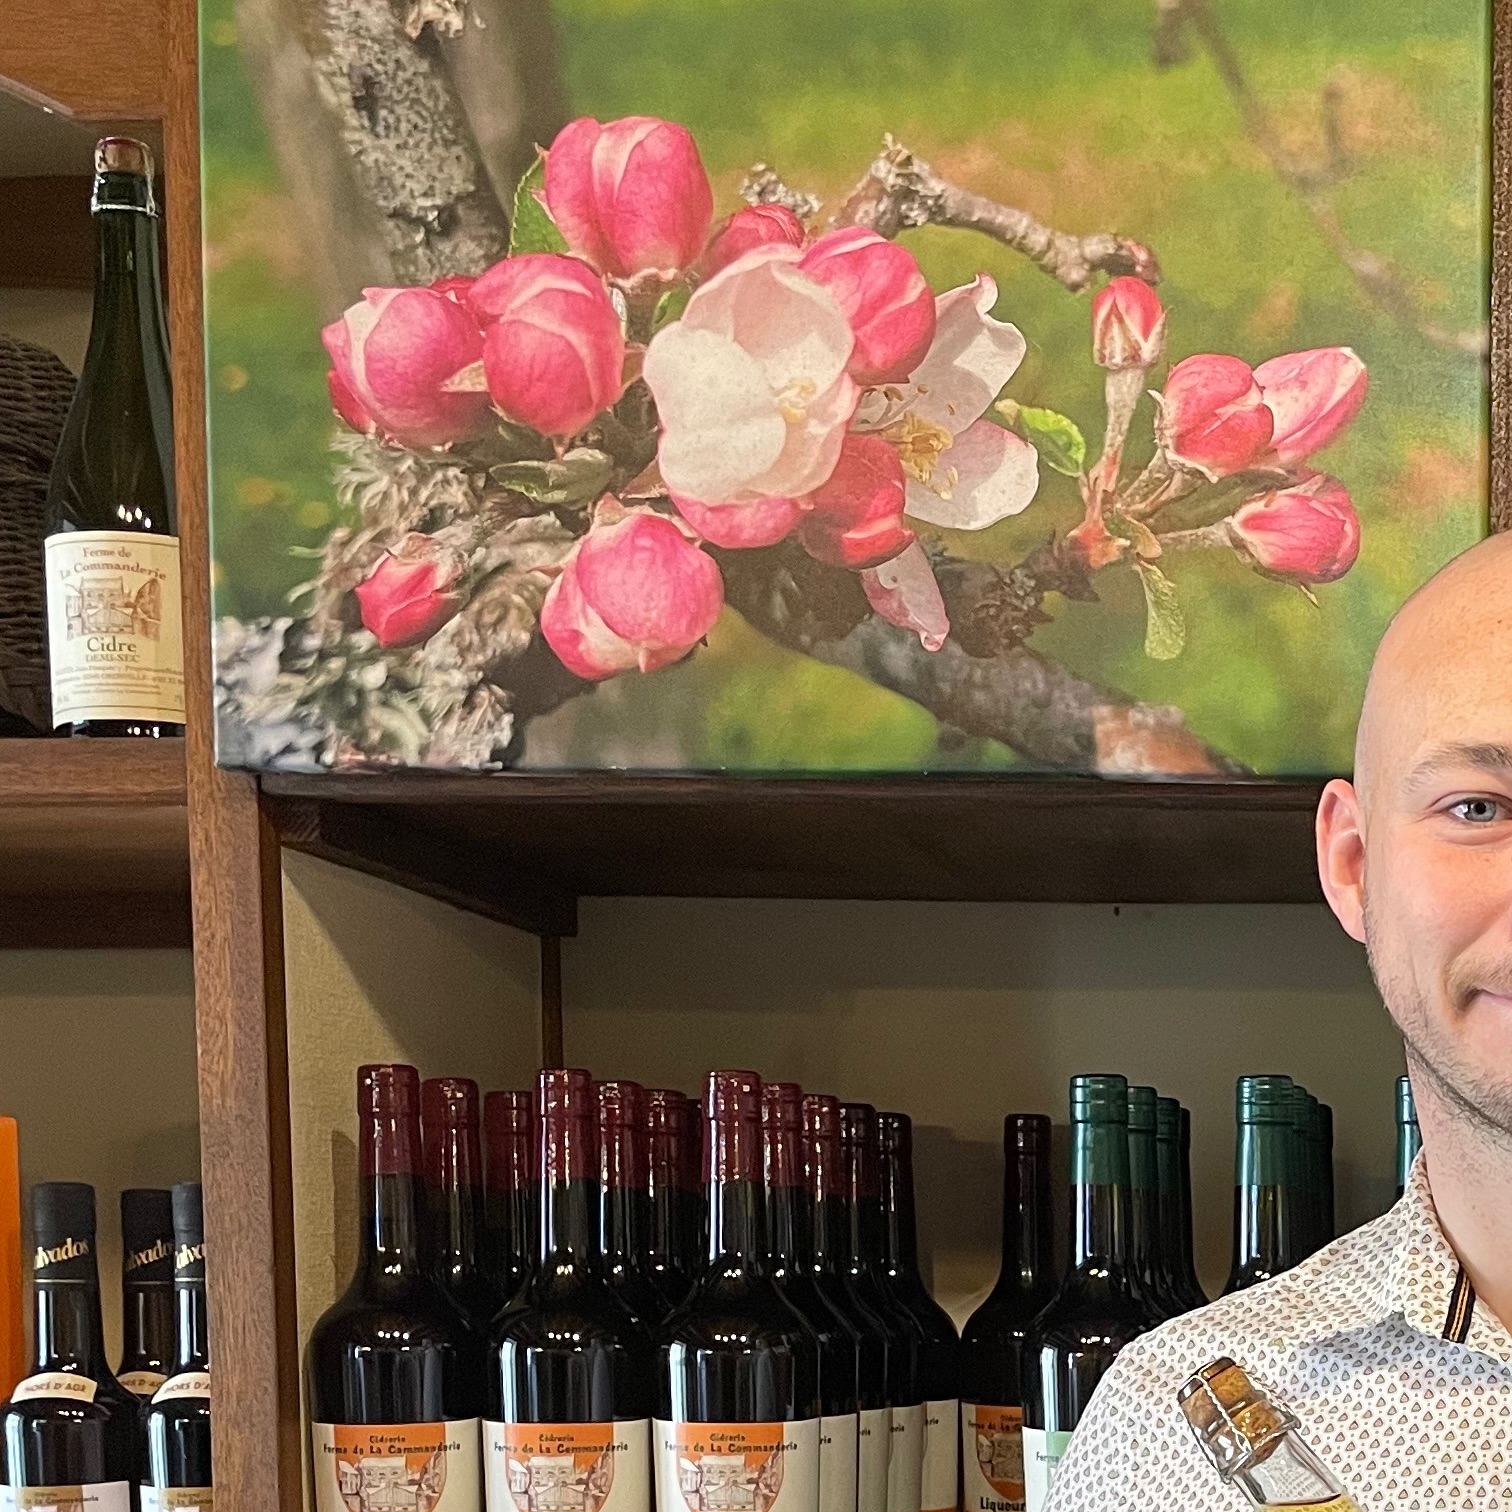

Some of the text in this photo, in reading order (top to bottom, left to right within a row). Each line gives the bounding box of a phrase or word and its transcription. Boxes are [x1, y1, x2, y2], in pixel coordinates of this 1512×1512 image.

[73, 562, 166, 580] Commanderie
[86, 636, 137, 653] Cidre
[34, 1237, 89, 1270] alvados
